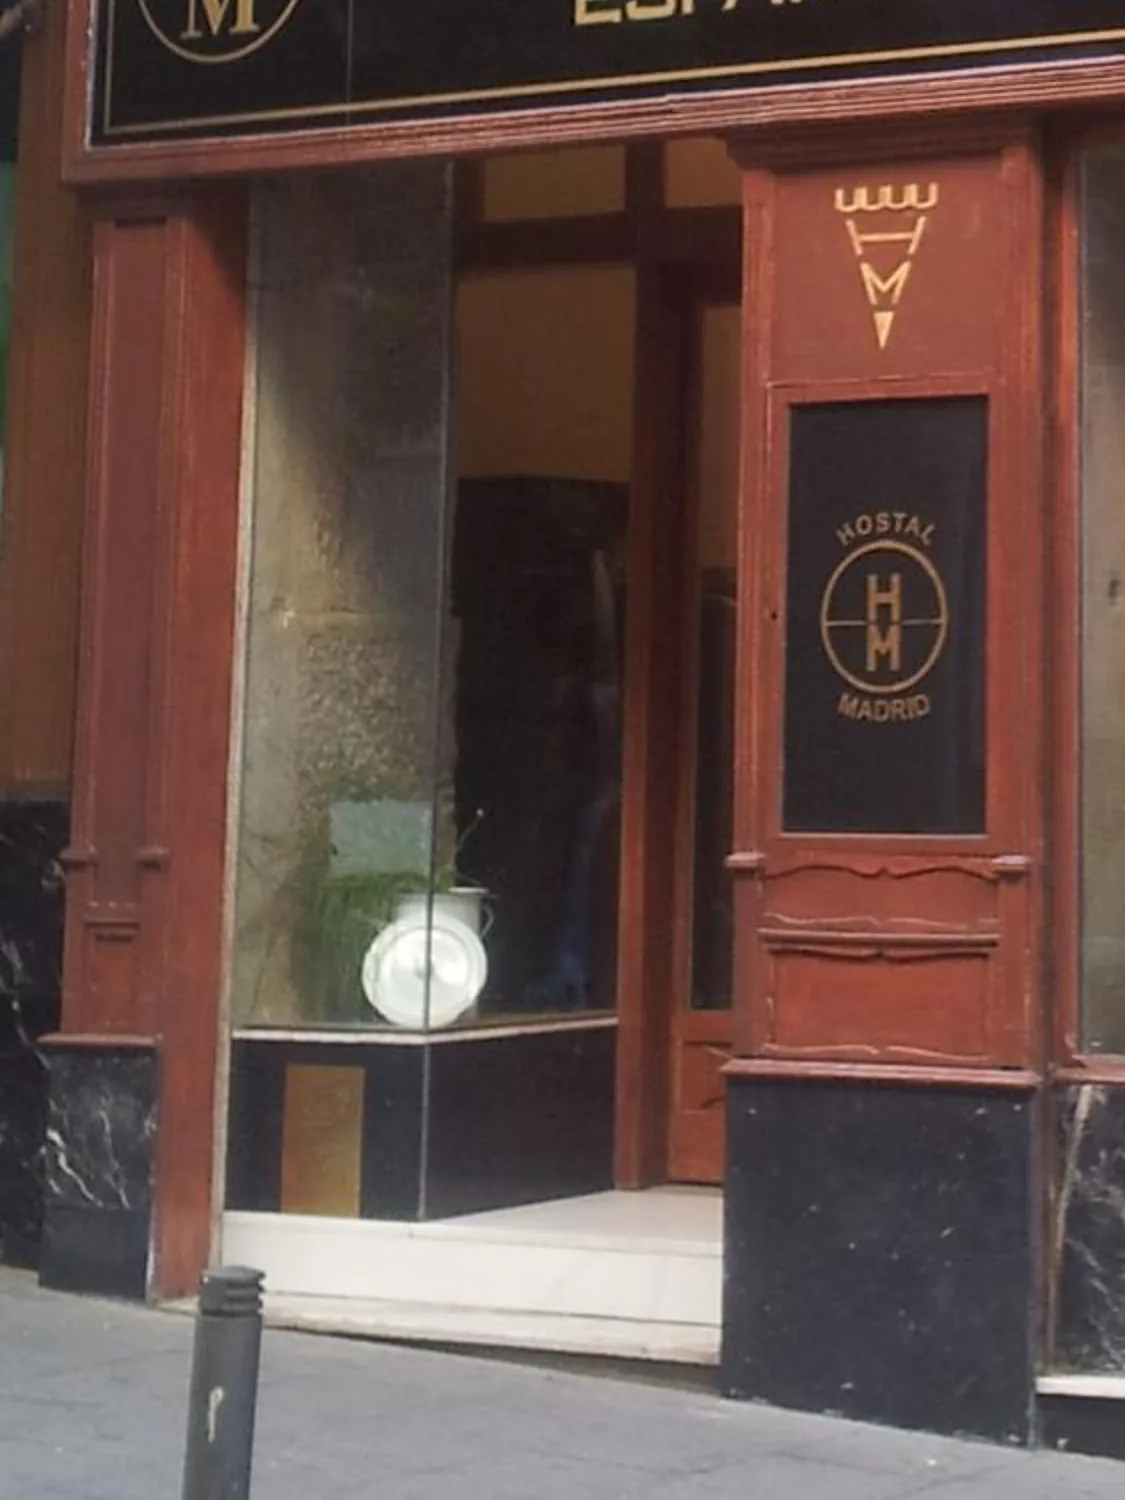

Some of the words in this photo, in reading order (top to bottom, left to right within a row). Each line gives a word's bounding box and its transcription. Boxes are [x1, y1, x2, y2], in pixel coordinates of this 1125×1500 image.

[835, 512, 936, 547] HOSTAL
[866, 573, 902, 624] H
[865, 624, 901, 673] M
[837, 692, 931, 723] MADRID
